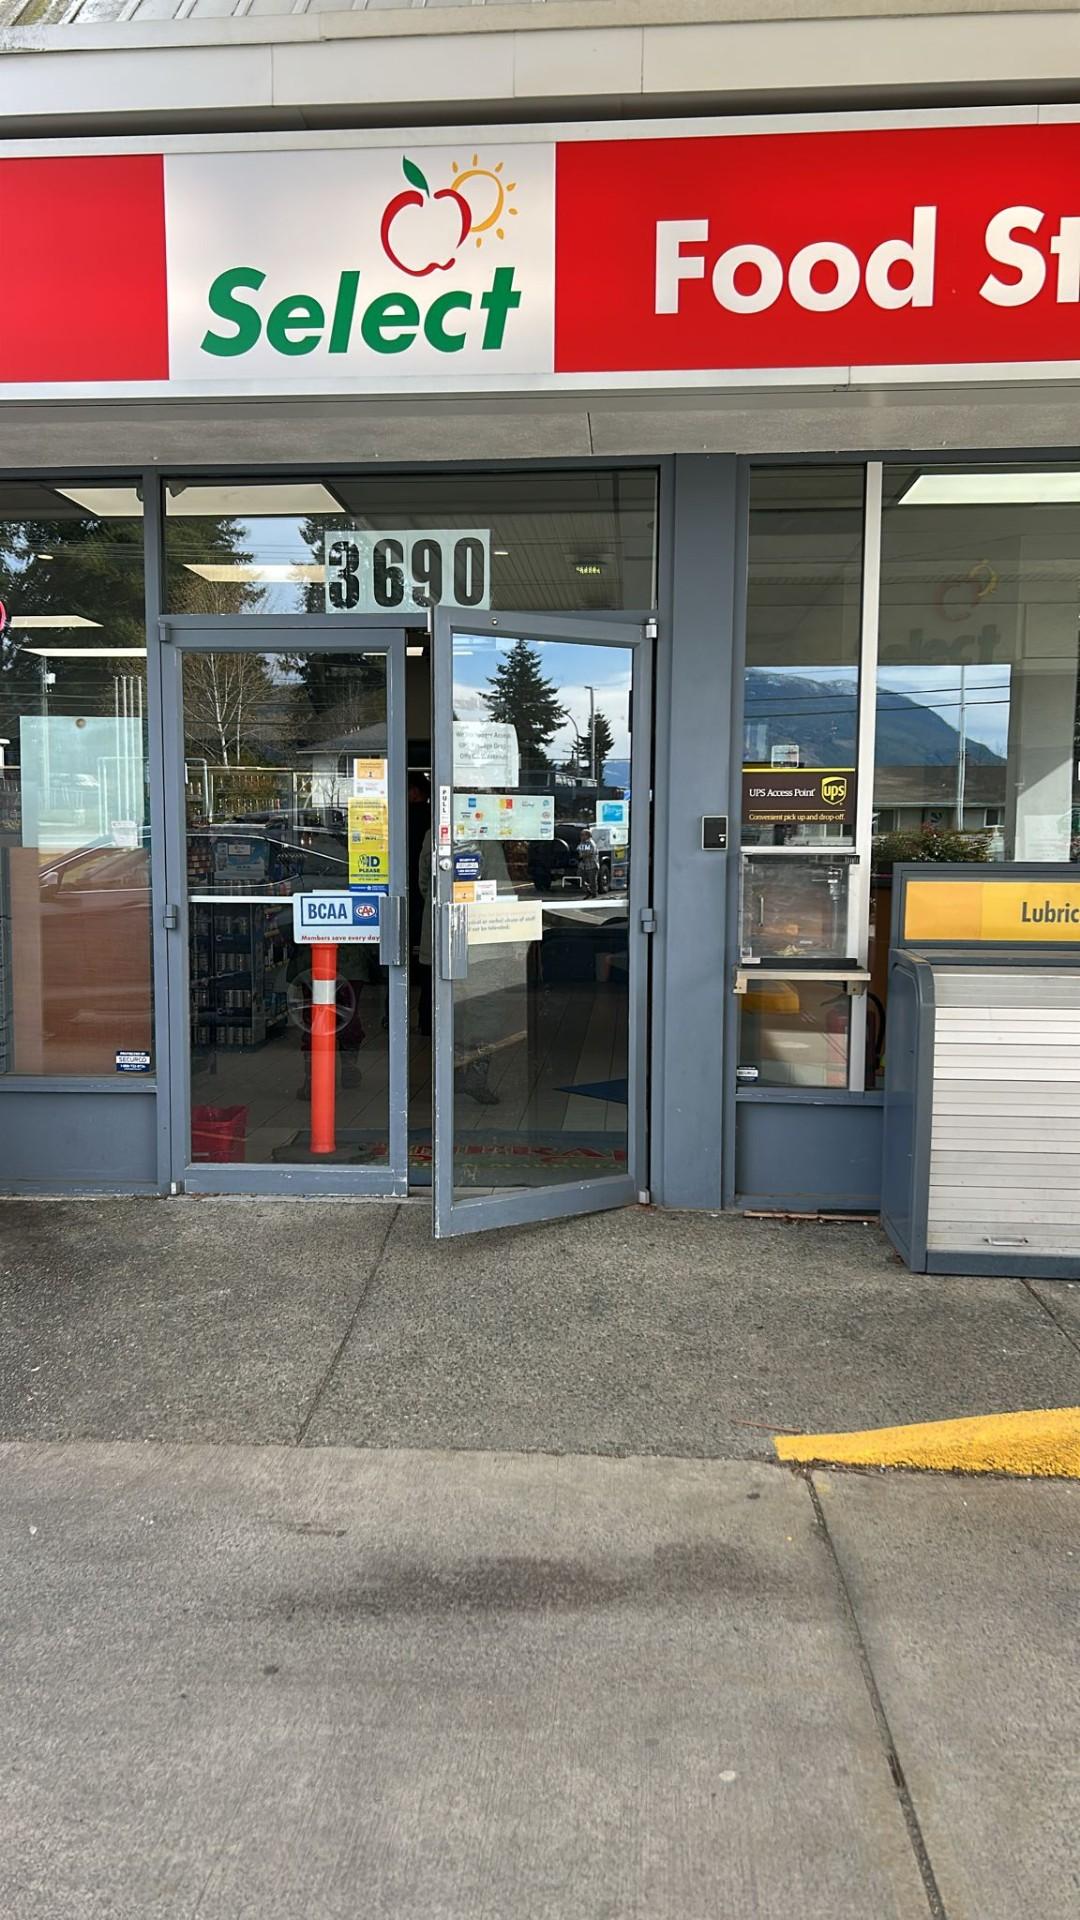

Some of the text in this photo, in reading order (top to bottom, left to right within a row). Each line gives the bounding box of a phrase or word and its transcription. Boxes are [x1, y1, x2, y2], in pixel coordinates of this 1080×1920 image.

[655, 205, 1080, 315] Food St
[200, 266, 522, 358] Select
[328, 536, 485, 610] 3690
[749, 788, 815, 797] UPS Access Point
[823, 785, 845, 801] ups
[748, 813, 783, 821] Convenient
[784, 813, 796, 822] pick
[805, 813, 818, 821] and
[307, 903, 348, 920] BCAA
[357, 906, 374, 916] CAA
[347, 935, 366, 943] every
[366, 934, 380, 943] day
